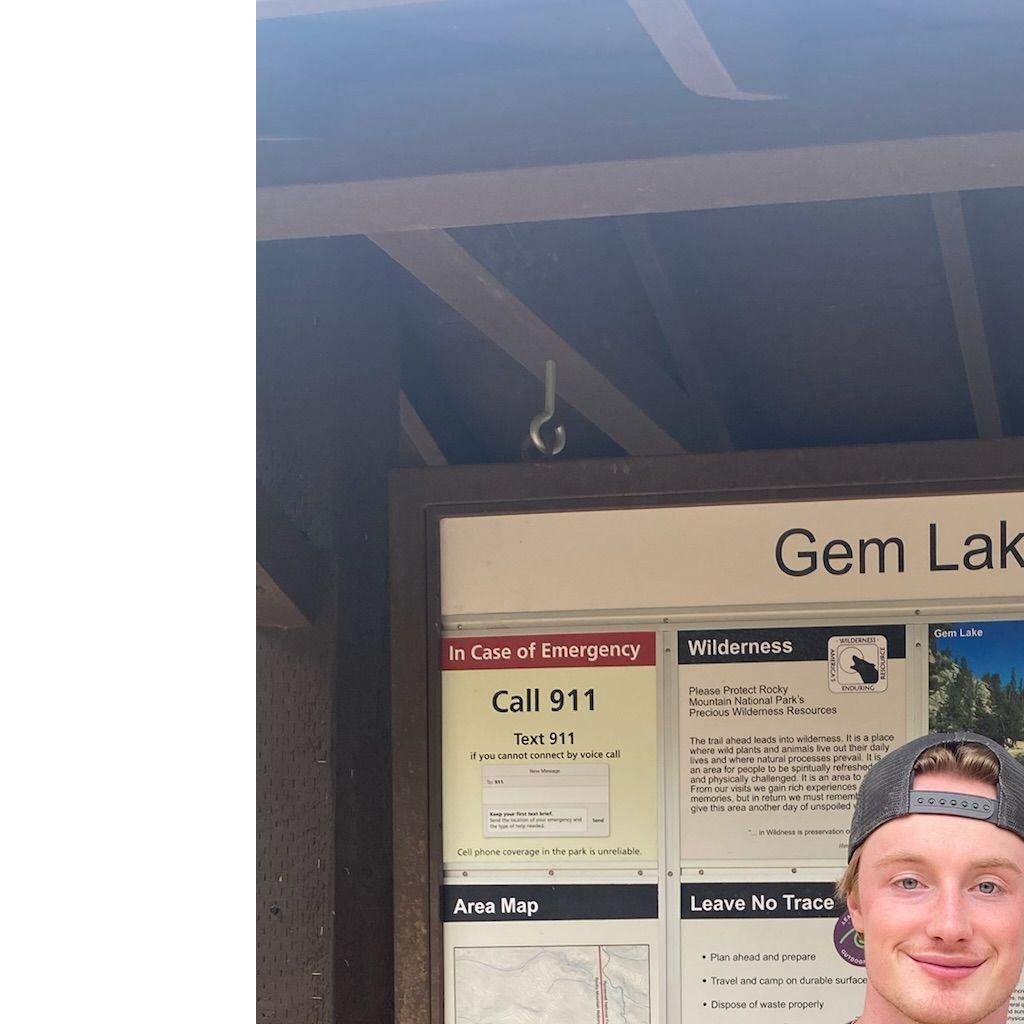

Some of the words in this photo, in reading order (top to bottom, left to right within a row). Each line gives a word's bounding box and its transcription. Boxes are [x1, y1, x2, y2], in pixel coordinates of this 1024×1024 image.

[774, 526, 905, 577] Gem
[933, 628, 956, 638] Gem
[959, 627, 983, 637] Lake
[449, 645, 465, 660] In
[470, 644, 511, 660] Case
[516, 641, 536, 659] of
[541, 641, 640, 661] Emergency
[687, 638, 793, 655] Wilderness
[688, 686, 720, 695] Please
[723, 685, 756, 695] Protect
[759, 684, 788, 696] Rocky
[491, 688, 539, 713] Call
[550, 688, 595, 711] 911
[688, 696, 732, 706] Mountain
[734, 695, 773, 705] National
[775, 694, 804, 704] Park's
[689, 707, 729, 717] Precious
[731, 706, 784, 716] Wilderness
[786, 705, 837, 715] Resources
[513, 732, 545, 745] Text
[549, 731, 575, 744] 911
[689, 736, 705, 745] The
[708, 736, 723, 744] trail
[725, 736, 751, 744] ahead
[753, 735, 776, 744] leads
[796, 734, 843, 743] wilderness.
[846, 733, 852, 742] It
[863, 734, 869, 742] a
[871, 732, 894, 744] place
[470, 751, 476, 759] if
[478, 753, 495, 761] you
[530, 751, 564, 759] connect
[566, 750, 577, 760] by
[580, 750, 603, 758] voice
[605, 749, 620, 758] call
[457, 848, 472, 856] Cell
[474, 848, 500, 857] phone
[502, 849, 539, 857] coverage
[552, 847, 566, 855] the
[568, 847, 586, 856] park
[589, 847, 595, 855] is
[597, 847, 640, 855] unreliable.
[453, 898, 495, 914] Area
[501, 896, 538, 916] Map
[690, 895, 745, 911] Leave
[751, 894, 777, 910] No
[783, 894, 834, 910] Trace
[710, 952, 730, 961] Plan
[732, 952, 760, 961] ahead
[762, 953, 779, 961] and
[781, 953, 816, 962] prepare
[710, 976, 738, 985] Travel
[739, 977, 757, 985] and
[758, 977, 783, 986] camp
[799, 976, 833, 984] durable
[711, 1000, 746, 1010] Dispose
[748, 999, 757, 1008] of
[759, 1000, 786, 1008] waste
[788, 1000, 824, 1010] properly
